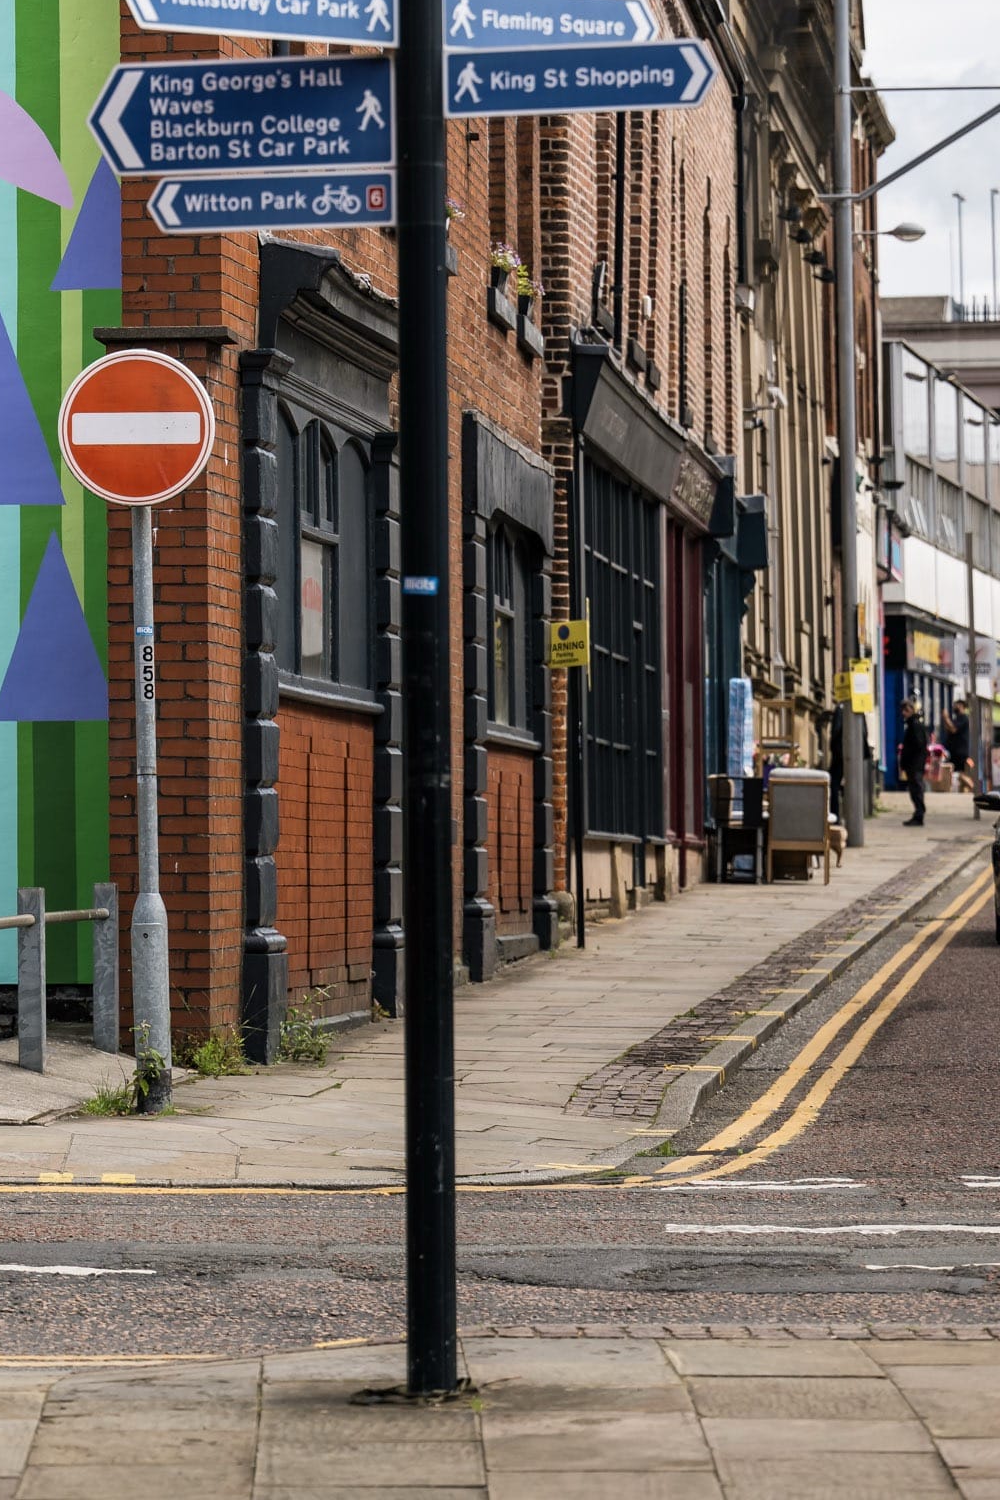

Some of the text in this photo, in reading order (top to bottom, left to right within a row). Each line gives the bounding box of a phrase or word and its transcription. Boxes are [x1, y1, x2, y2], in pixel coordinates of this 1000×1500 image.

[481, 8, 626, 37] Fleming Square
[150, 67, 344, 96] King George's Hall
[490, 64, 675, 93] King St Shopping
[150, 98, 215, 116] Waves
[150, 114, 341, 139] Blackburn College
[150, 134, 350, 162] Barton St Car Park
[184, 190, 307, 213] Witton Park
[549, 640, 585, 652] ARNING
